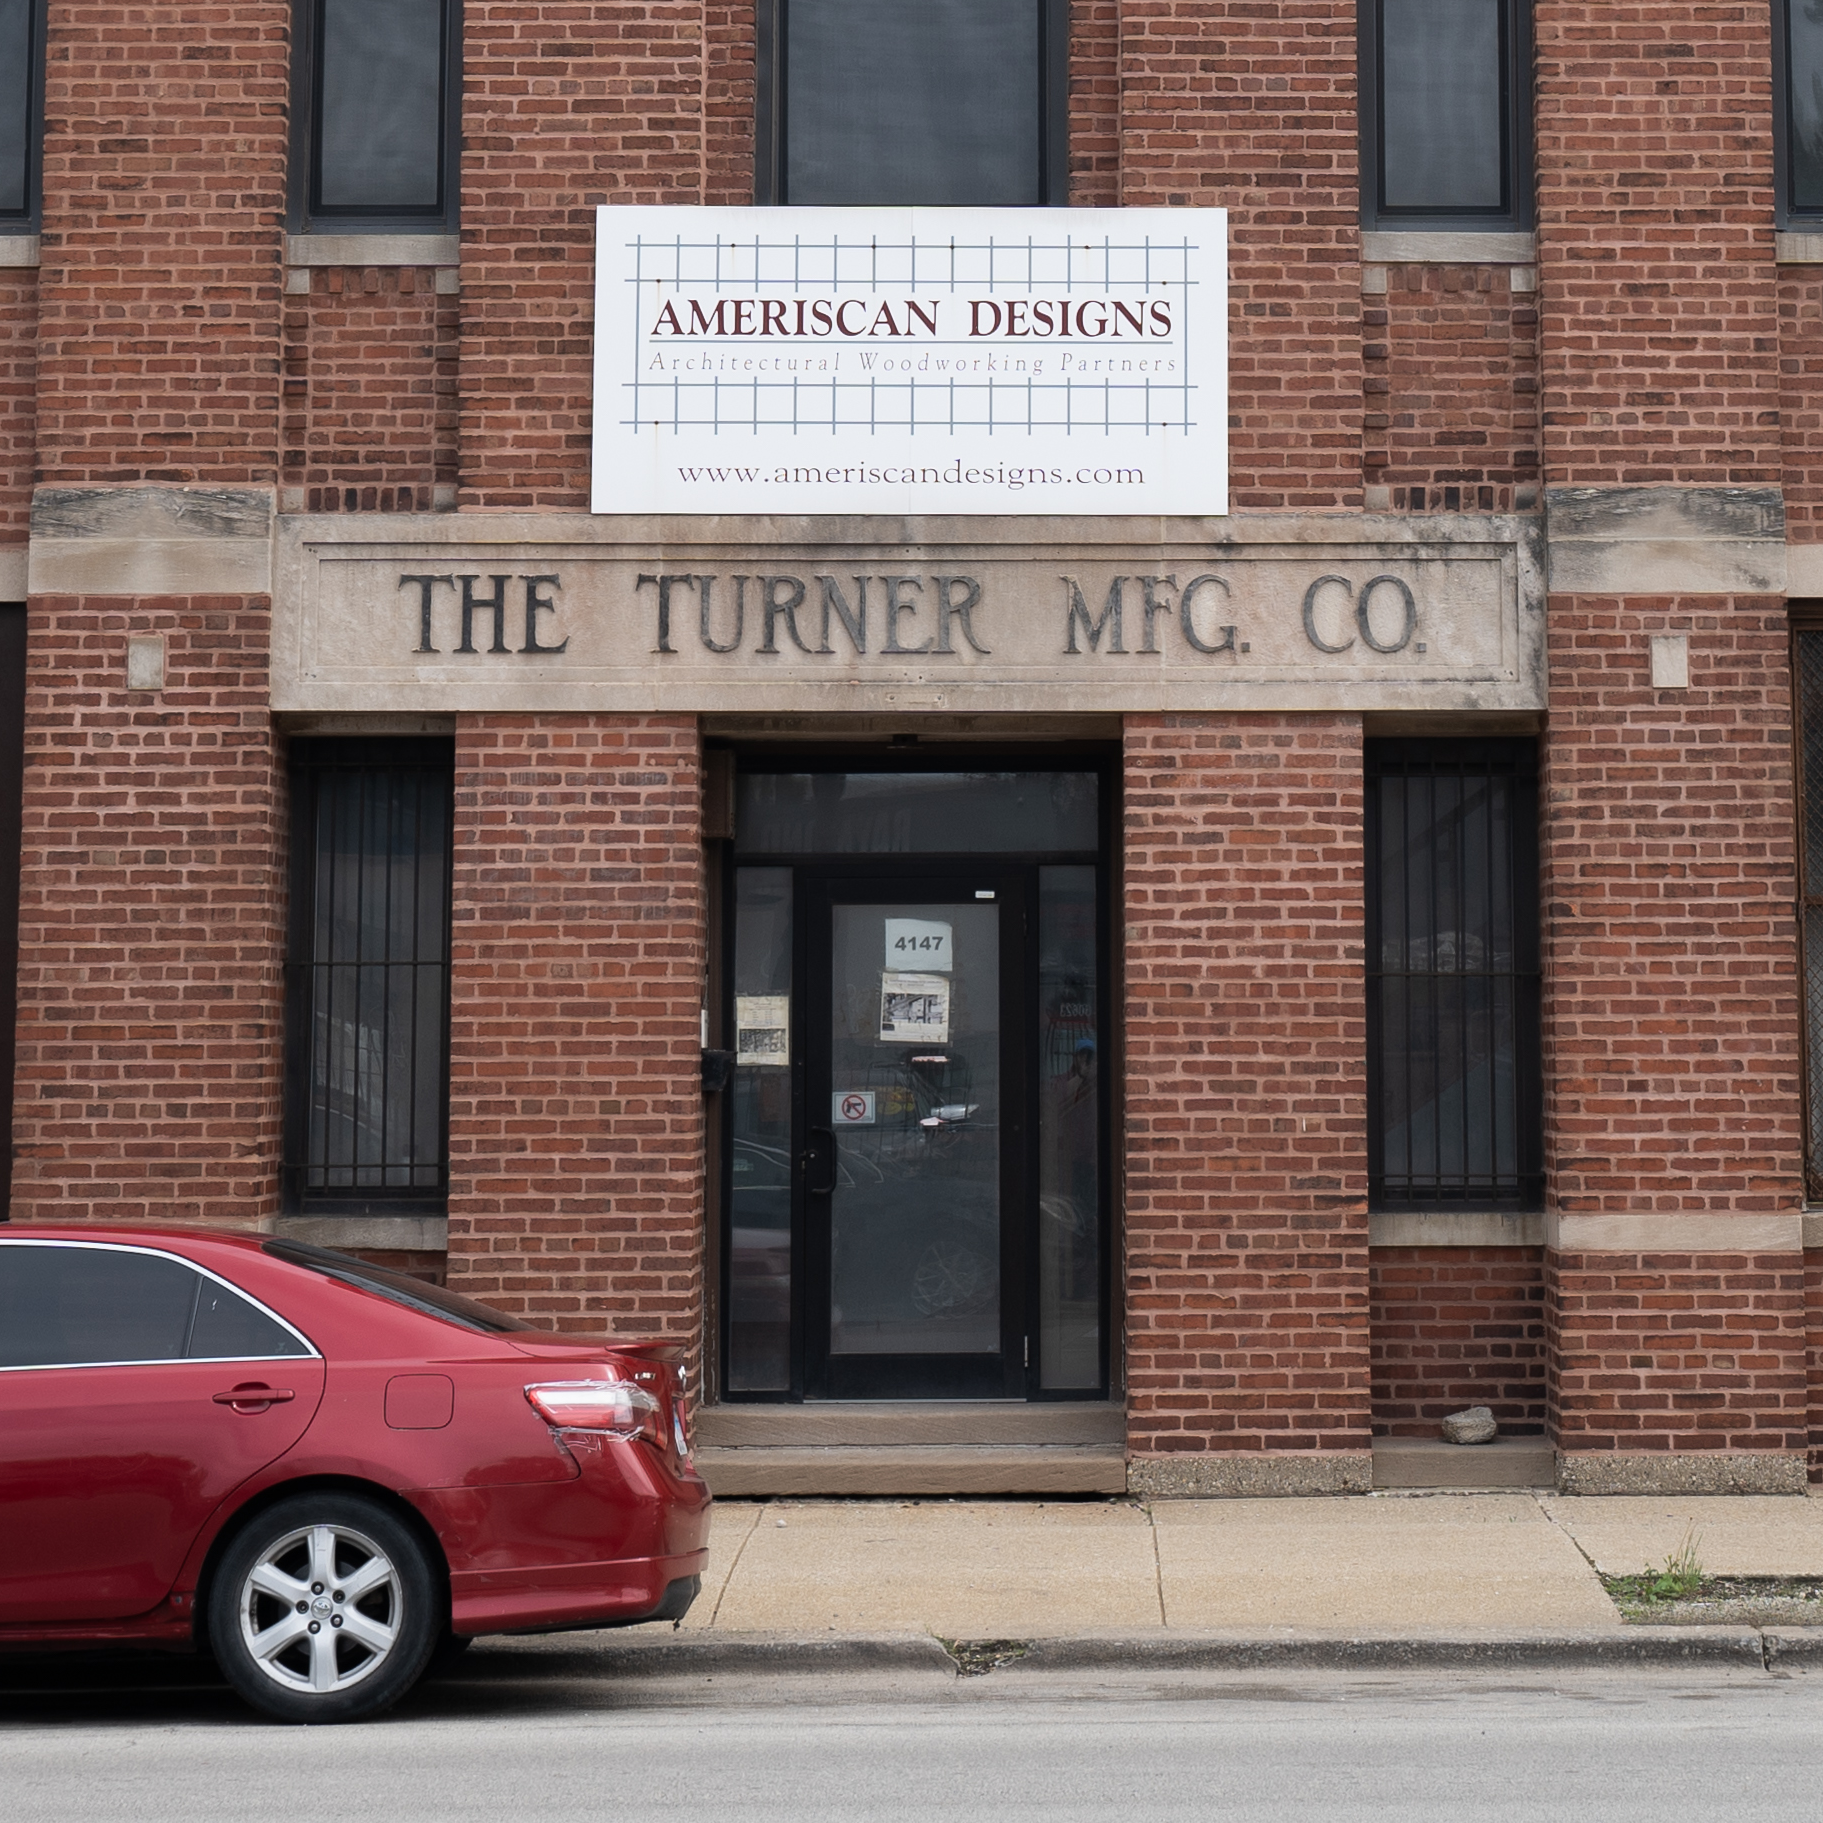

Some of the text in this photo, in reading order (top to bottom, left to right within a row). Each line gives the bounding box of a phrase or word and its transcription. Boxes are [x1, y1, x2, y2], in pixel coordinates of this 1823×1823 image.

[650, 299, 1172, 338] AMERISCAN DESIGNS
[649, 352, 1176, 376] Architectural Woodworking Partners
[677, 458, 1145, 490] www.ameriscandesigns.com
[398, 573, 1427, 655] THE TURNER MFG. CO.
[895, 936, 944, 951] 4147
